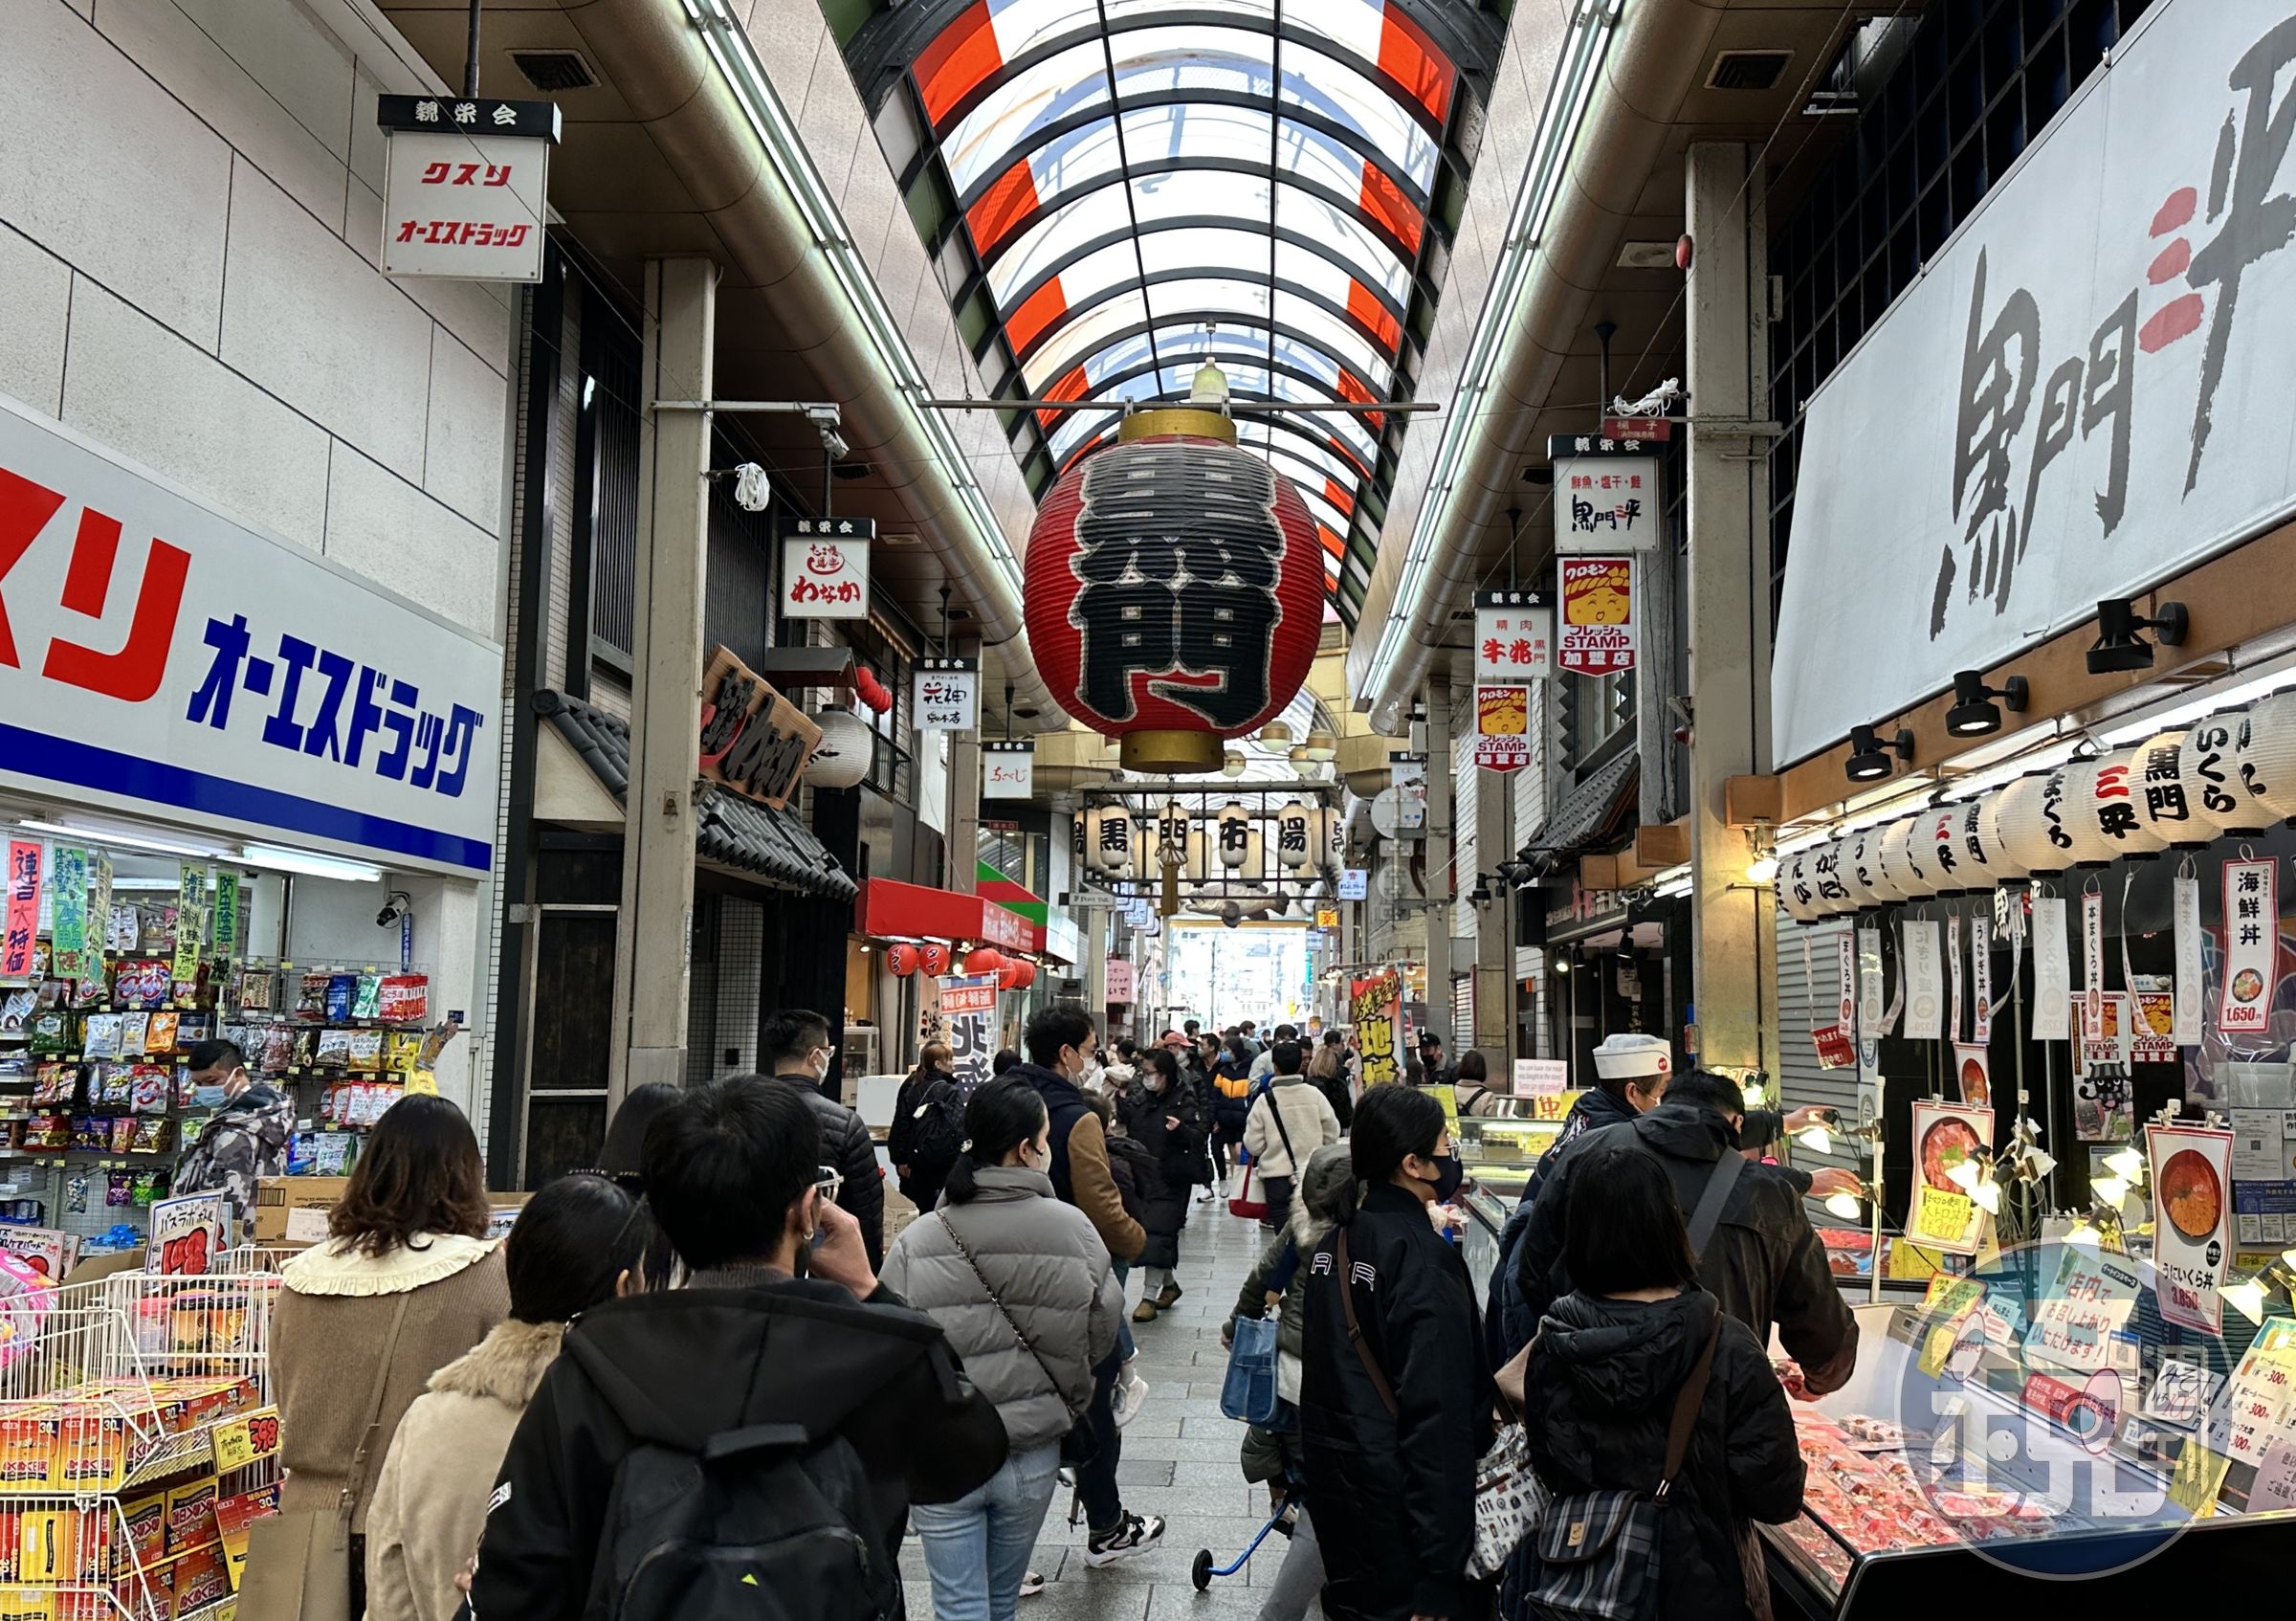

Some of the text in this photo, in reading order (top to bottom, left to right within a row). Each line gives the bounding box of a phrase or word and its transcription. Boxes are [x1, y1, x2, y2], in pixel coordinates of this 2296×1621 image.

[421, 162, 513, 187] クスリ
[396, 220, 533, 247] オーエスドラッグ
[1572, 494, 1642, 533] 黒門三平
[1565, 564, 1608, 580] クロモン
[790, 575, 861, 604] わなか
[1495, 619, 1533, 632] 精肉
[1569, 625, 1623, 636] フレッシュ
[1563, 635, 1630, 649] STAMP
[1564, 651, 1631, 665] 加盟店
[186, 613, 484, 798] オーエスドラッグ
[1479, 690, 1512, 701] クロモン
[1478, 743, 1527, 752] STAMP
[1483, 734, 1521, 743] フレッシュ
[1478, 753, 1527, 765] 加盟店
[2197, 727, 2237, 813] いくら
[2145, 744, 2190, 822] 黒門
[2043, 772, 2073, 849] まぐろ
[2096, 766, 2141, 839] 三平
[1100, 815, 1306, 854] 黒門市場
[1965, 802, 1987, 864] 黒門
[2237, 871, 2262, 945] 海鮮丼
[2088, 904, 2098, 986] 本まぐろ丼
[1843, 941, 1853, 996] まぐろ丼
[1976, 924, 1987, 992] うなぎ丼
[2139, 996, 2158, 1006] ロモン
[2084, 1043, 2119, 1052] STAMP
[2132, 1041, 2175, 1051] STAMP
[2134, 1052, 2175, 1062] 加盟店
[1311, 1253, 1333, 1276] A
[2064, 1271, 2112, 1305] 店内で
[2162, 1262, 2215, 1292] うにいくら丼
[2045, 1301, 2112, 1335] お召し上がり
[227, 1390, 238, 1403] 30
[2164, 1392, 2197, 1422] 100
[165, 1408, 176, 1420] 30
[39, 1421, 54, 1434] 30
[258, 1496, 274, 1509] 30
[160, 1574, 172, 1588] 30
